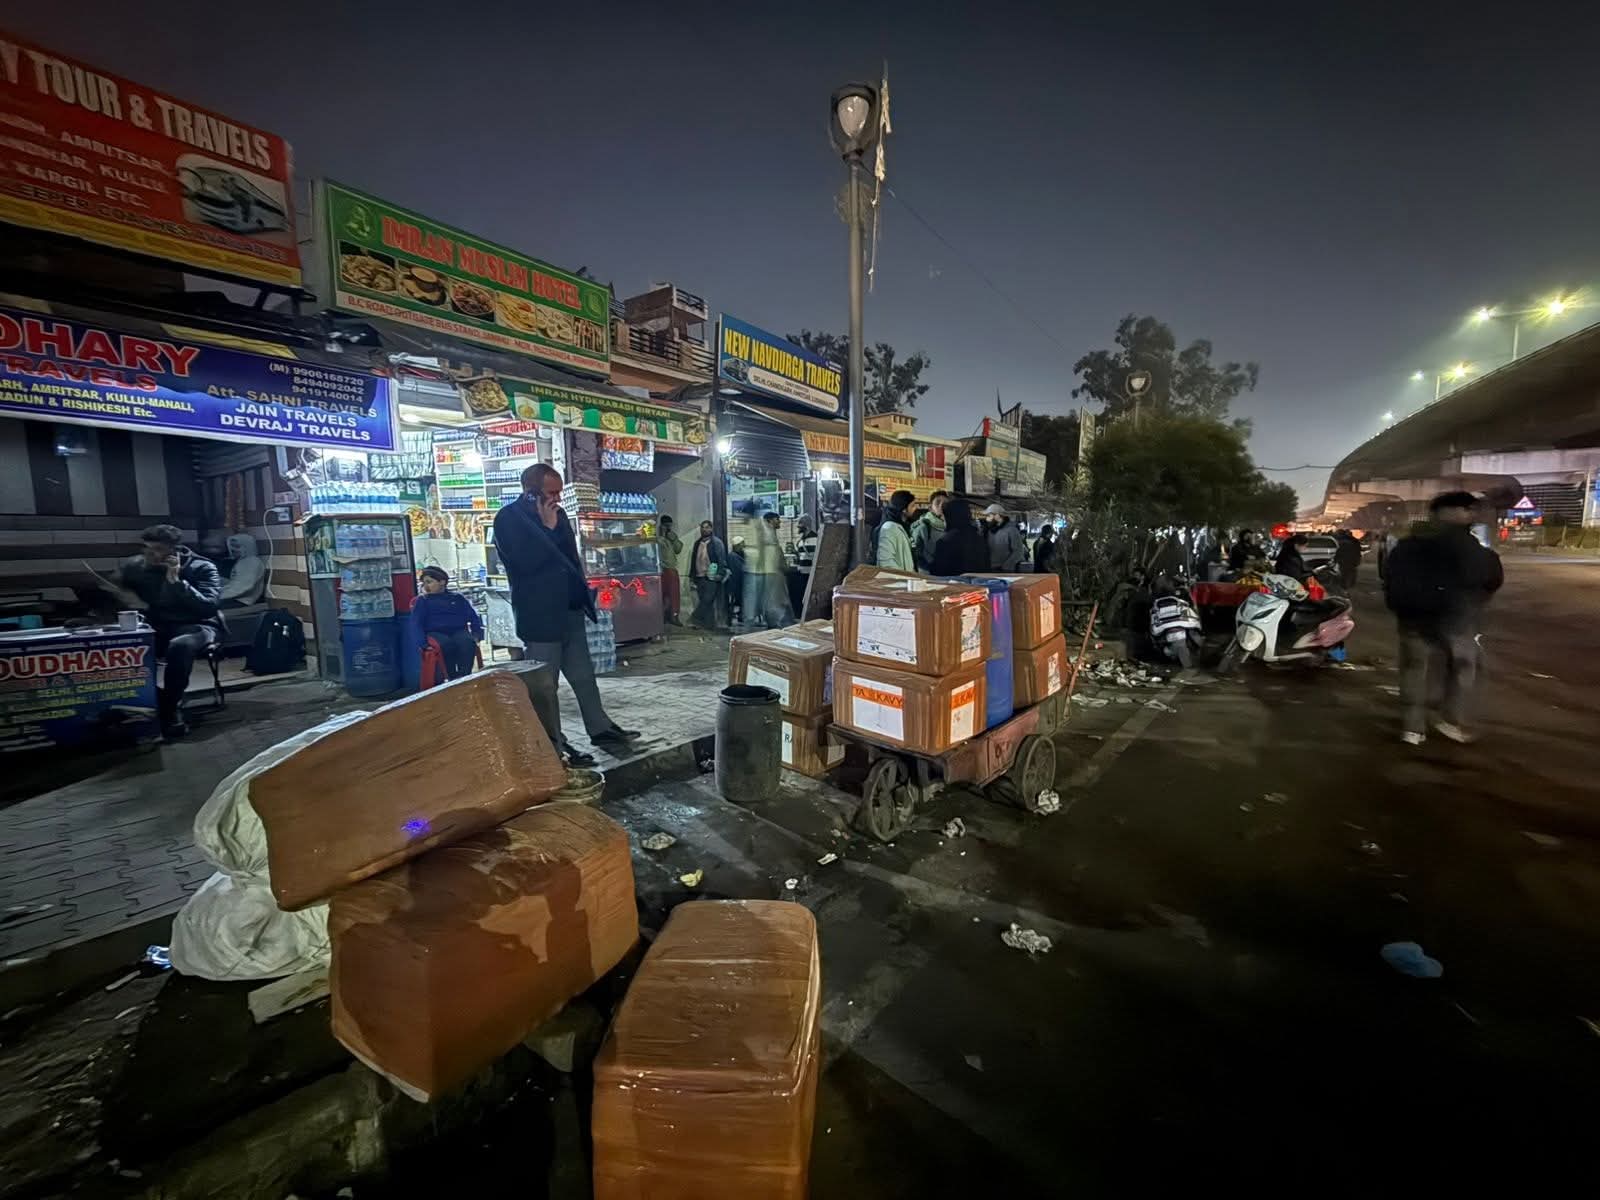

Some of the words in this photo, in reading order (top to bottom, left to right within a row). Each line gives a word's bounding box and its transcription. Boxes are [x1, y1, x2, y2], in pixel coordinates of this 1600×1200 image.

[24, 49, 123, 121] TOUR
[128, 94, 152, 130] &
[155, 96, 272, 171] TRAVELS
[382, 215, 454, 268] IMRAN
[458, 242, 529, 293] MUSLIM
[532, 270, 582, 310] HOTEL
[269, 361, 289, 374] (M)
[724, 327, 751, 361] NEW
[751, 338, 804, 383] NAVDURGA
[805, 361, 841, 396] TRAVELS
[48, 396, 59, 407] &
[62, 399, 130, 417] RISHIKESH
[133, 407, 158, 419] Etc.
[235, 402, 278, 417] JAIN
[282, 408, 358, 428] TRAVELS
[247, 390, 302, 408] SAHNI
[306, 398, 378, 419] TRAVELS
[530, 385, 570, 400] IMRAN
[570, 390, 635, 412] HYDERABADI
[635, 404, 671, 418] BIRYANI
[220, 413, 293, 433] DEVRAJ
[297, 423, 371, 442] TRAVELS
